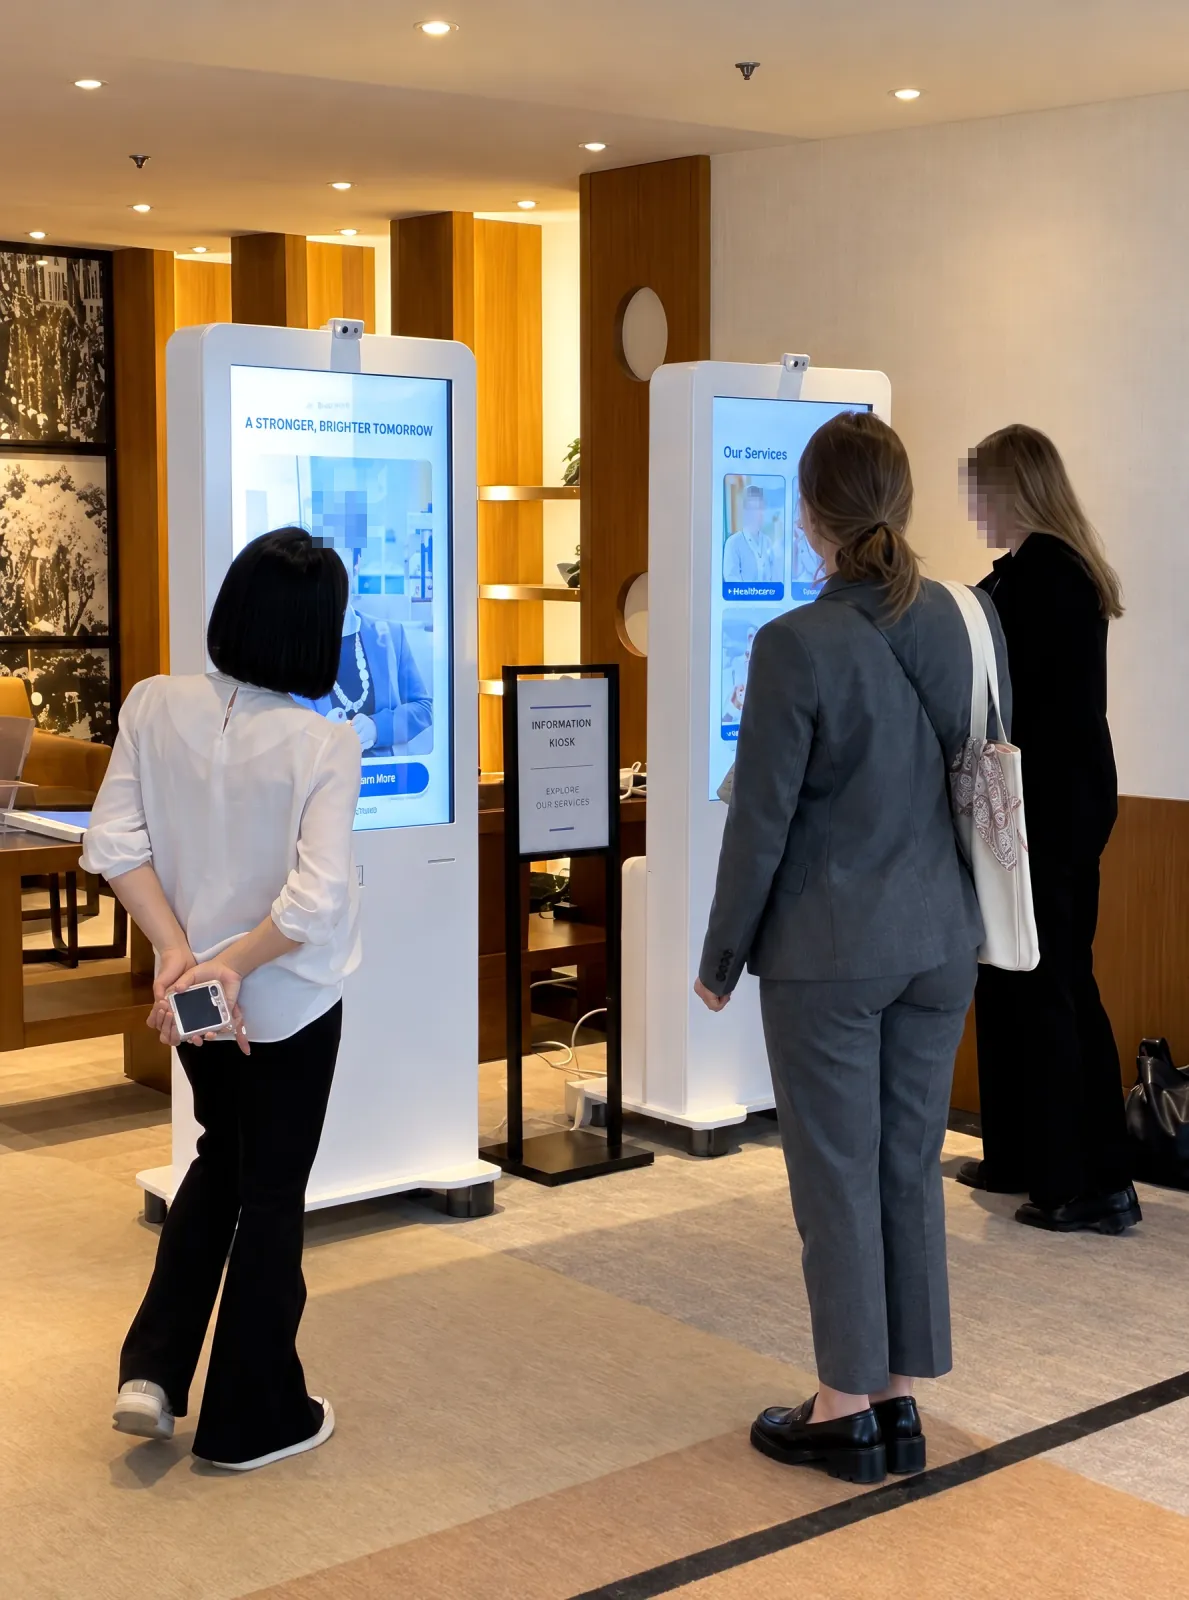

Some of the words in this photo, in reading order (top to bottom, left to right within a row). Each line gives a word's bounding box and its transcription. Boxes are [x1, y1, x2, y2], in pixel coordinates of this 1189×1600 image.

[245, 416, 253, 429] A
[256, 417, 317, 433] STRONGER,
[319, 420, 371, 434] BRIGHTER
[373, 423, 433, 436] TOMORROW
[724, 446, 743, 459] Our
[745, 447, 787, 460] Services
[532, 719, 591, 730] INFORMATION
[550, 737, 575, 748] KIOSK
[361, 776, 375, 785] arn
[376, 774, 396, 784] More
[546, 786, 580, 795] EXPLORE
[536, 800, 552, 810] OUR
[554, 798, 590, 808] SERVICES
